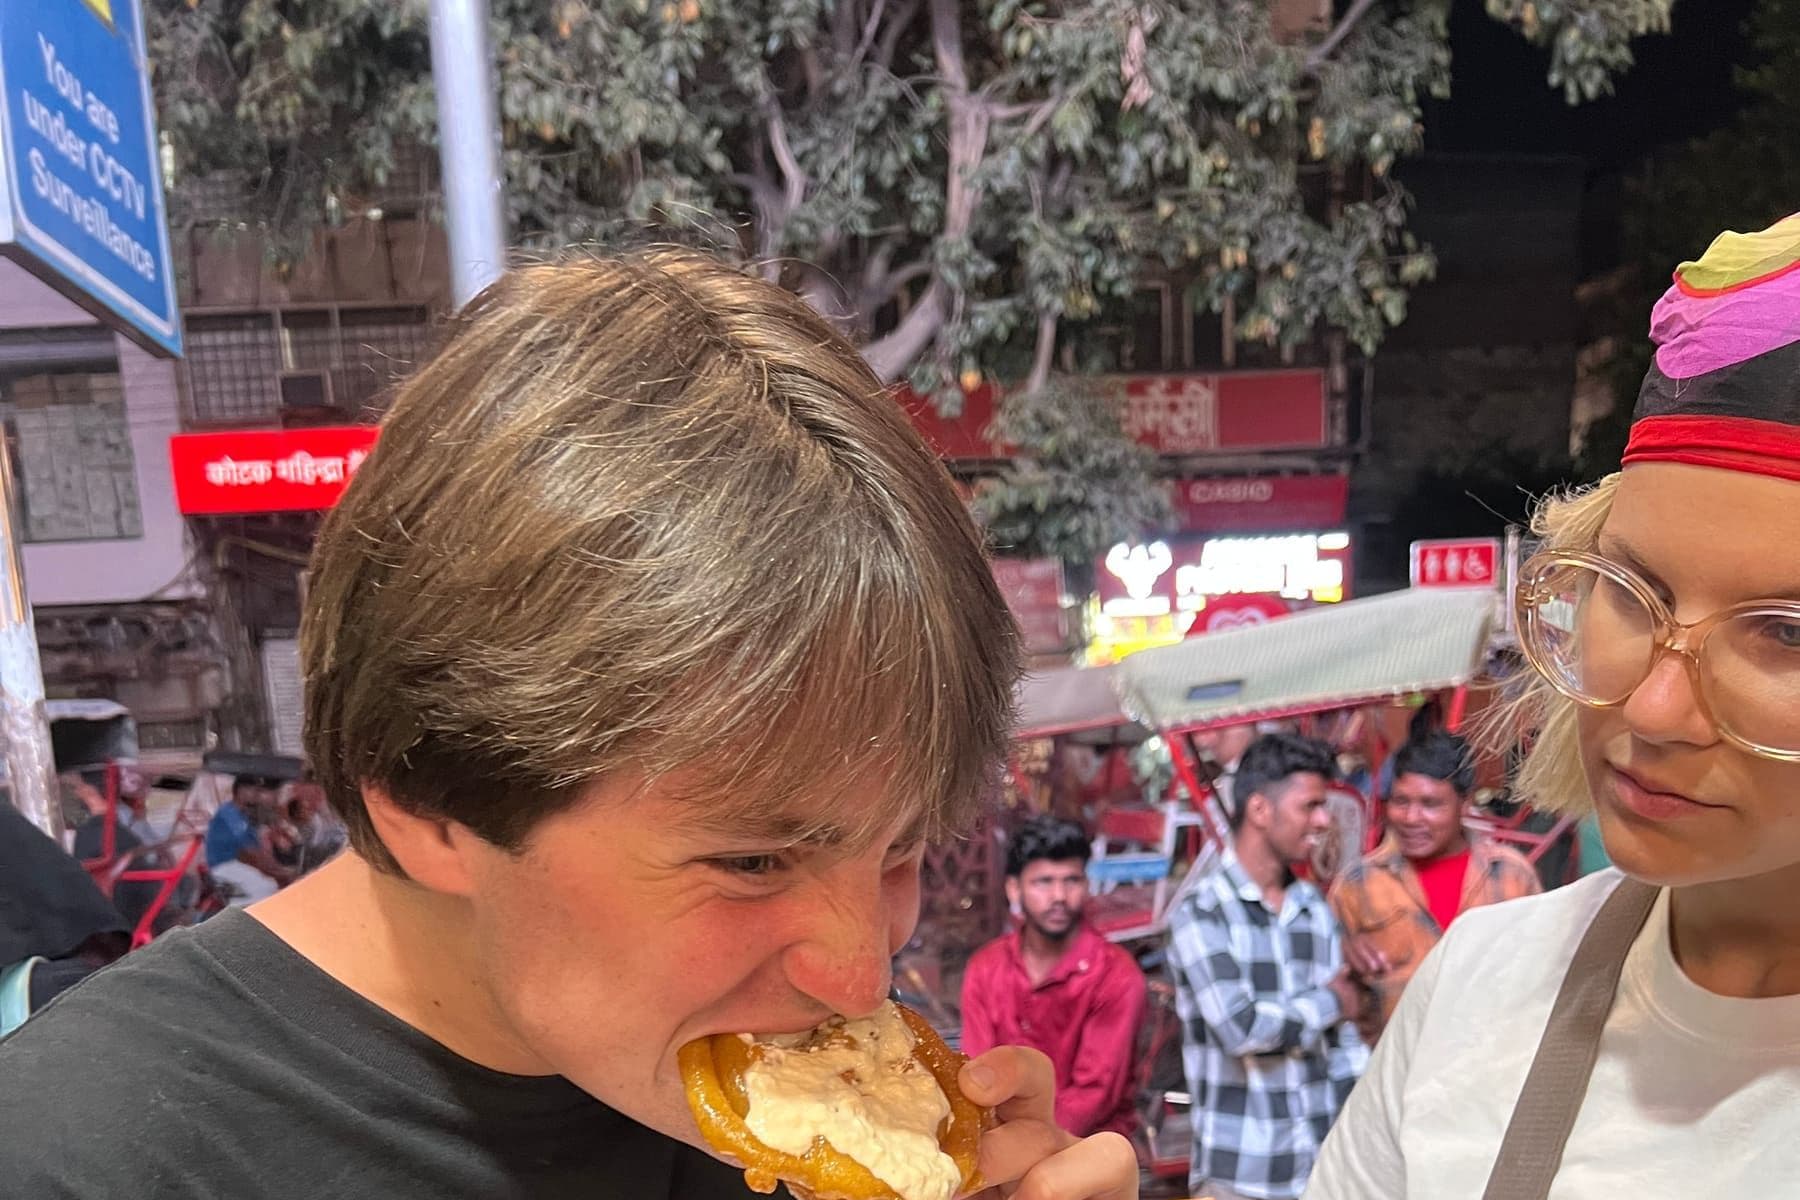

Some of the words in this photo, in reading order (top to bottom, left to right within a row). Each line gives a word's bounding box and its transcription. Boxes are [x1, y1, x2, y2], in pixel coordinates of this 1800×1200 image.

[38, 32, 84, 112] You
[86, 91, 120, 143] are
[23, 89, 87, 172] under
[89, 142, 146, 221] CCTV
[29, 147, 156, 283] Surveillance
[205, 454, 272, 486] कोटक
[1189, 480, 1274, 503] CASIO
